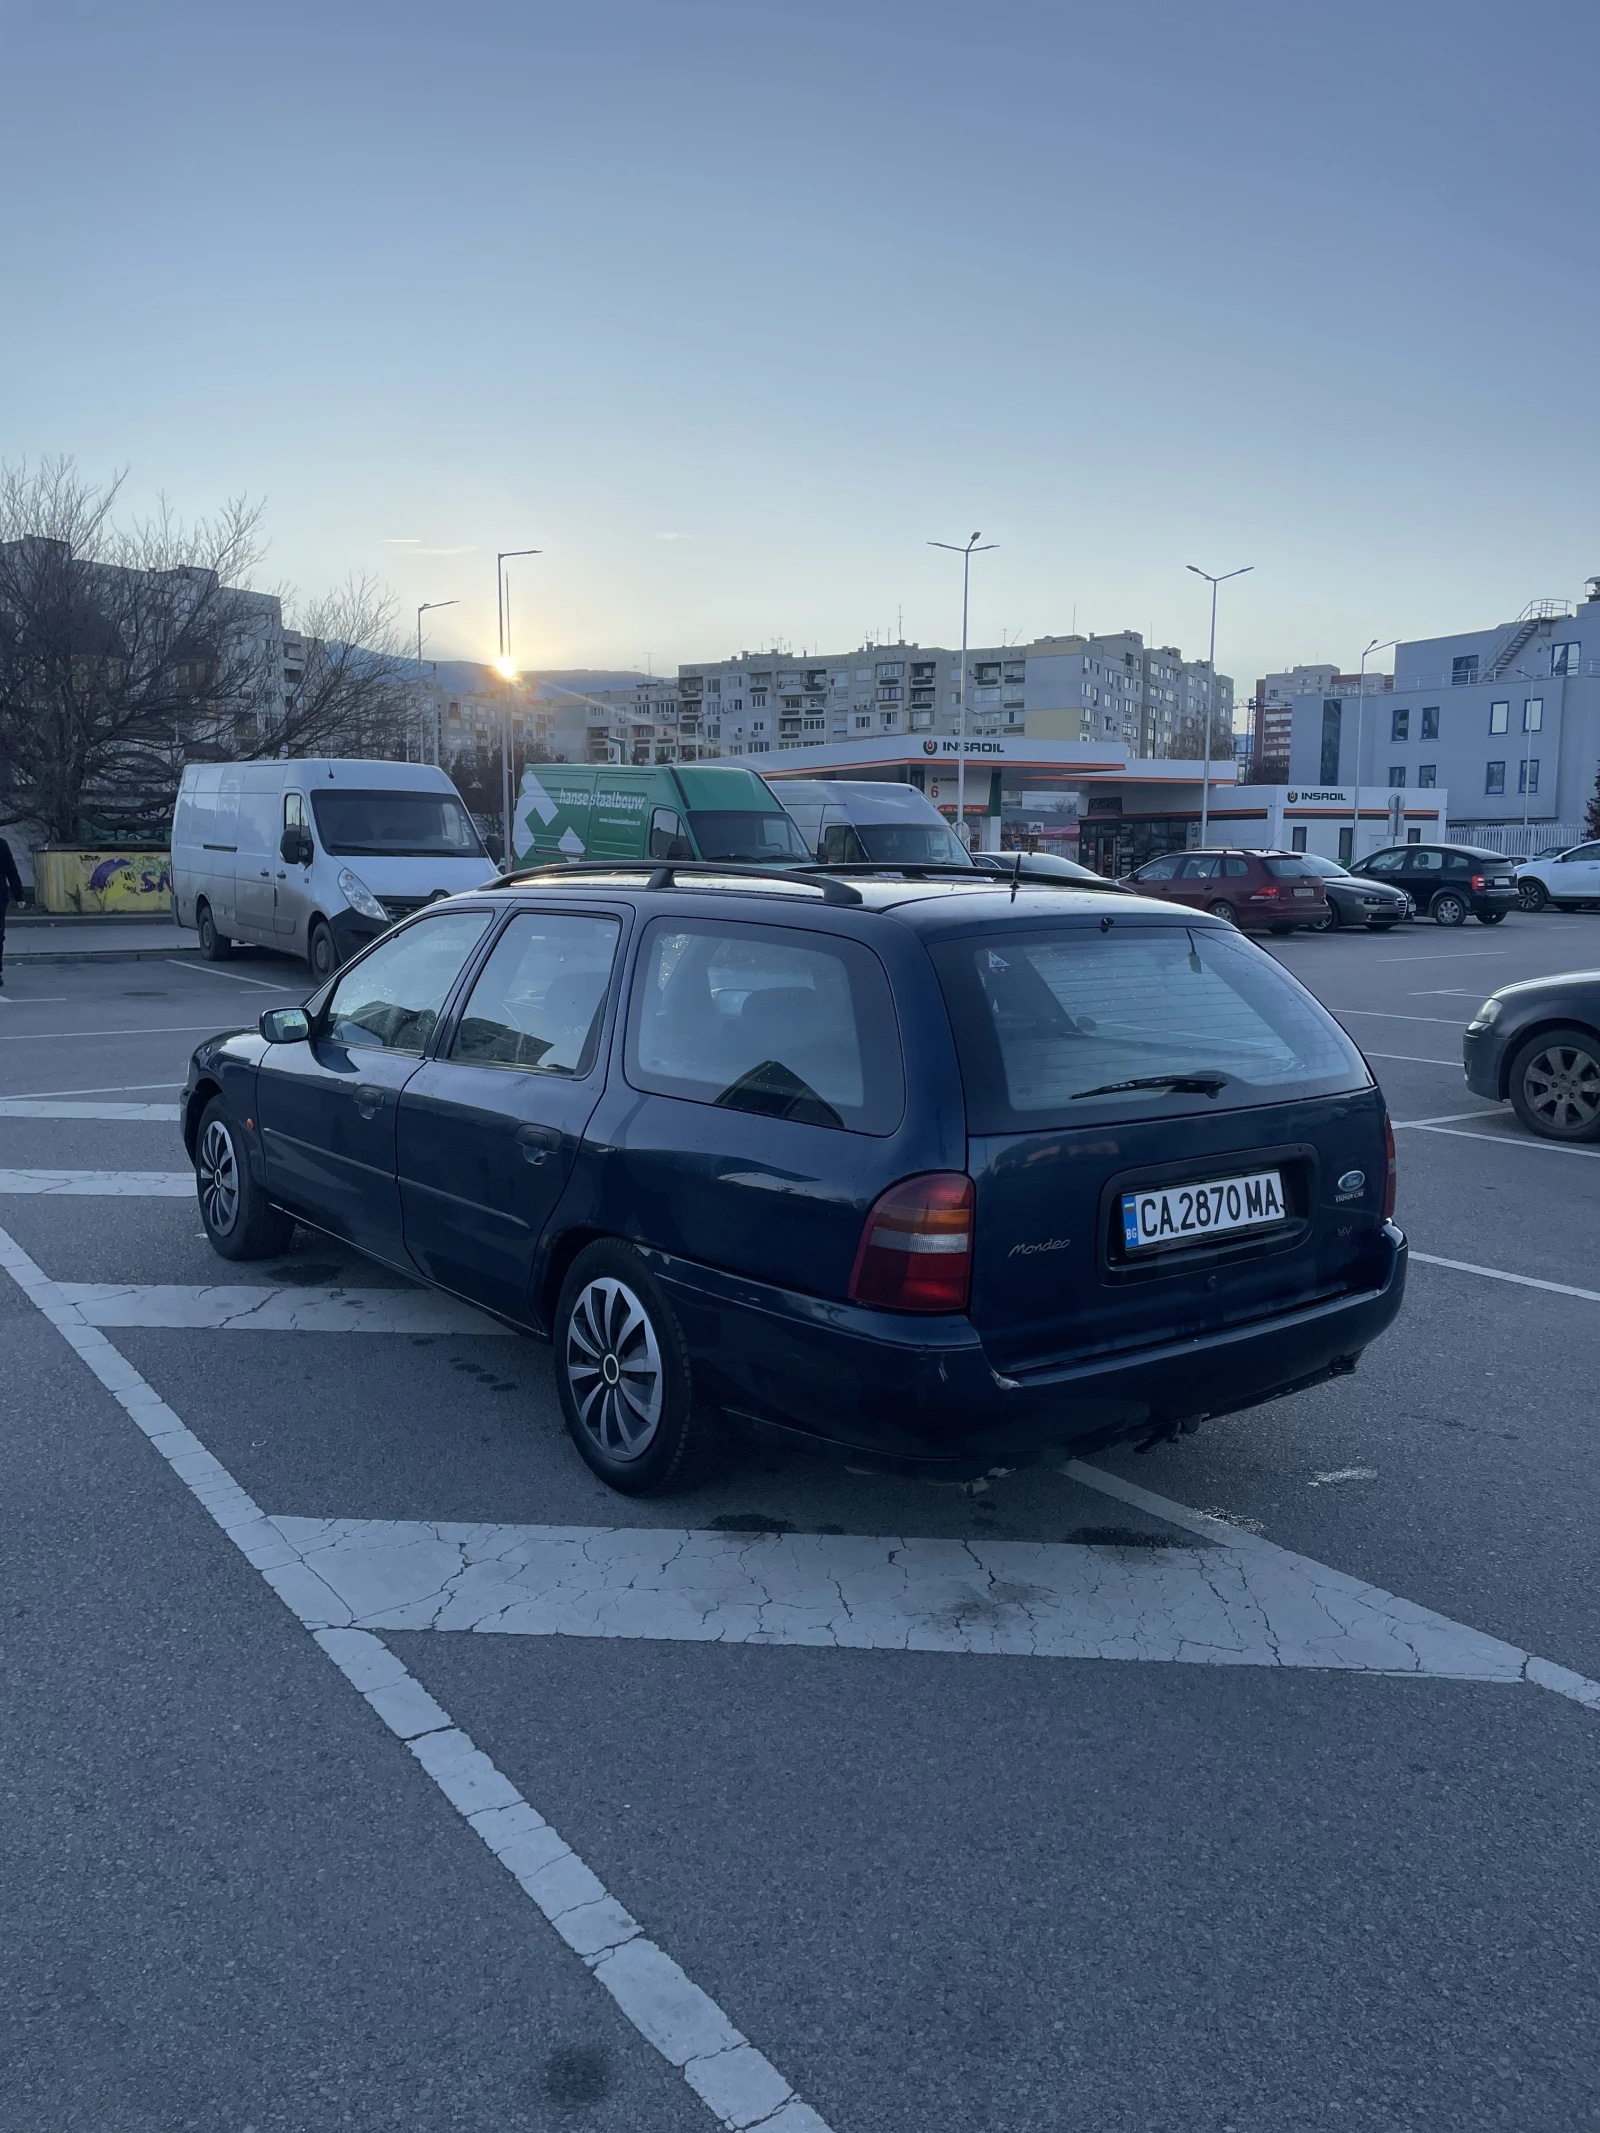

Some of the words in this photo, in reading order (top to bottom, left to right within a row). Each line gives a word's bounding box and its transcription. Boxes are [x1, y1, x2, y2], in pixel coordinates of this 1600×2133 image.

[943, 741, 1005, 753] INSAOIL
[931, 785, 939, 798] 6
[1301, 792, 1347, 801] INSAOIL
[559, 788, 589, 806] hanse
[590, 791, 646, 810] staalbouw
[1126, 1227, 1138, 1240] BG
[1007, 1238, 1071, 1257] Mondeo
